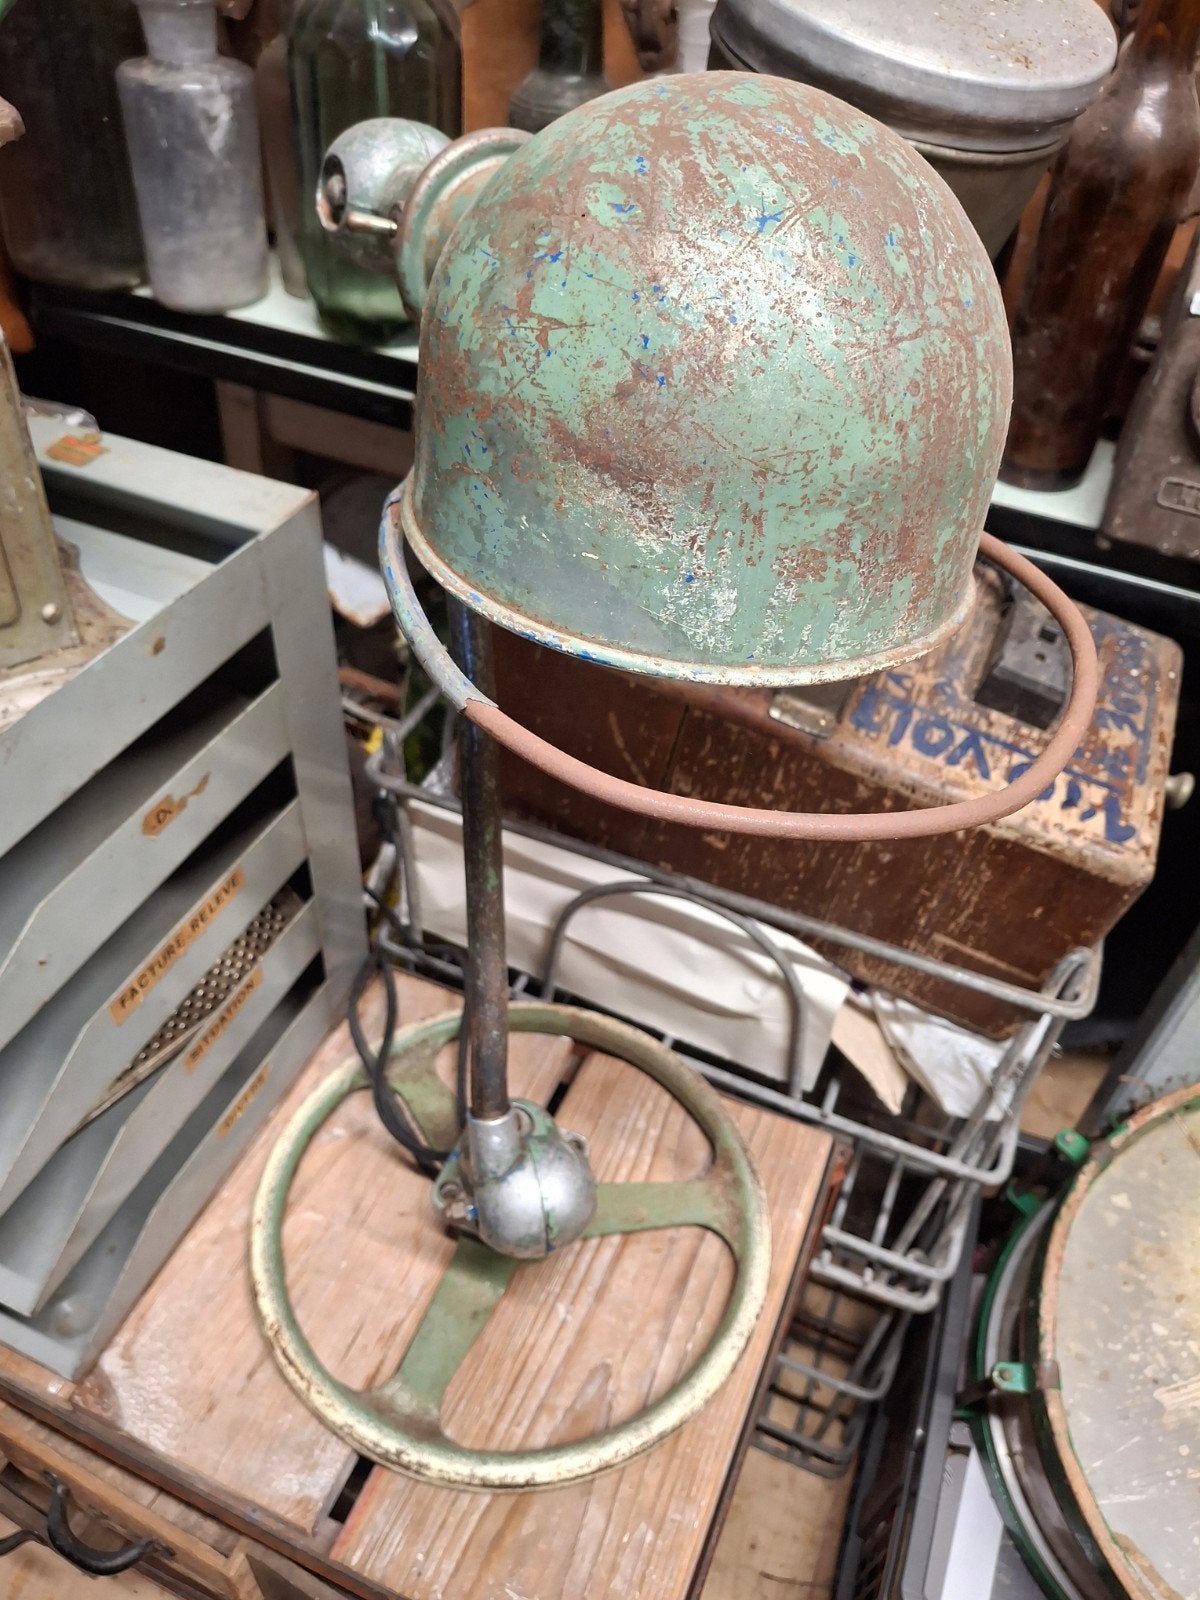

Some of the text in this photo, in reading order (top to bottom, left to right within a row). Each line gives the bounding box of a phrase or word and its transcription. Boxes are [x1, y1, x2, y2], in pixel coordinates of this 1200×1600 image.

[850, 688, 991, 781] VOLT
[118, 877, 239, 1010] FACTURE RELEVE
